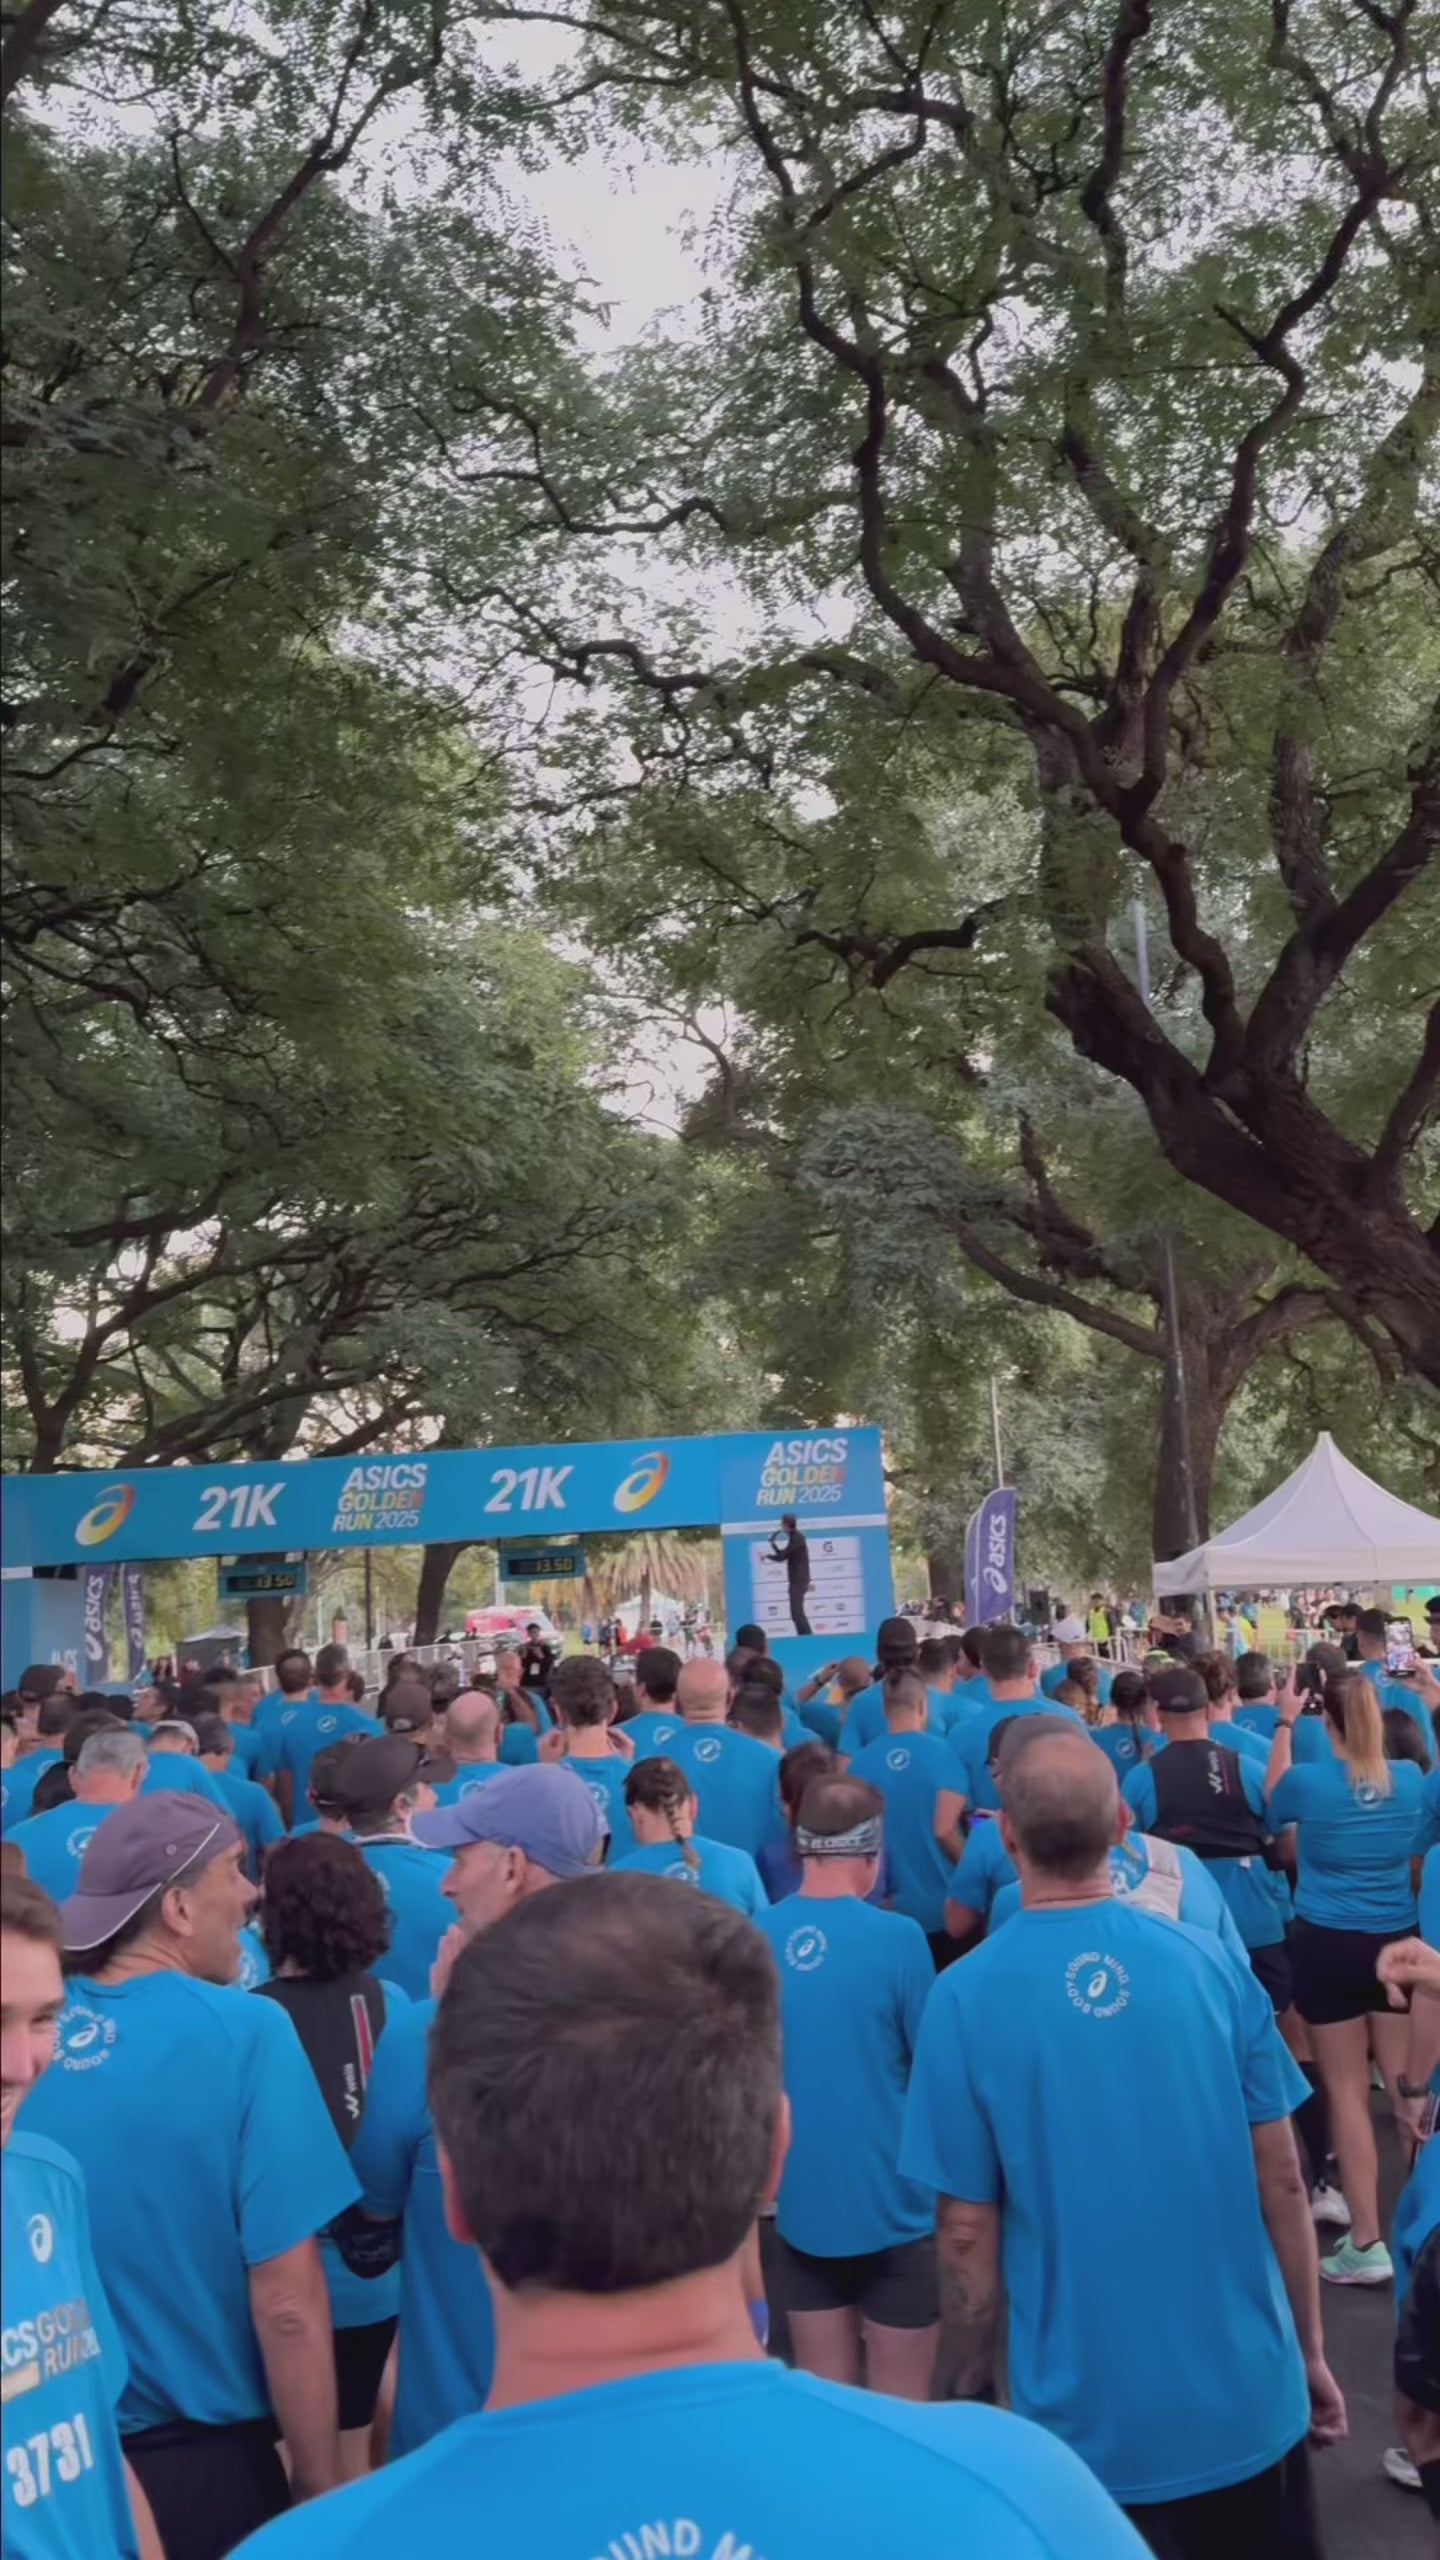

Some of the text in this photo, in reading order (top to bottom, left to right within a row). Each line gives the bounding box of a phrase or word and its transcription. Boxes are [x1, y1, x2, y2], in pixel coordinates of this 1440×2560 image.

[763, 1437, 848, 1466] ASICS
[342, 1463, 428, 1492] ASICS
[484, 1465, 575, 1513] 21K
[761, 1465, 846, 1487] GOLDEN
[192, 1482, 287, 1531] 21K
[337, 1490, 424, 1512] GOLDEN
[756, 1484, 842, 1505] RUN 2025
[331, 1510, 419, 1532] RUN 2025
[988, 1514, 1006, 1567] asics
[1104, 1954, 1129, 1984] MIND
[1093, 1989, 1130, 2018] SOUND
[1, 2320, 40, 2371] CS
[6, 2412, 94, 2507] 3731
